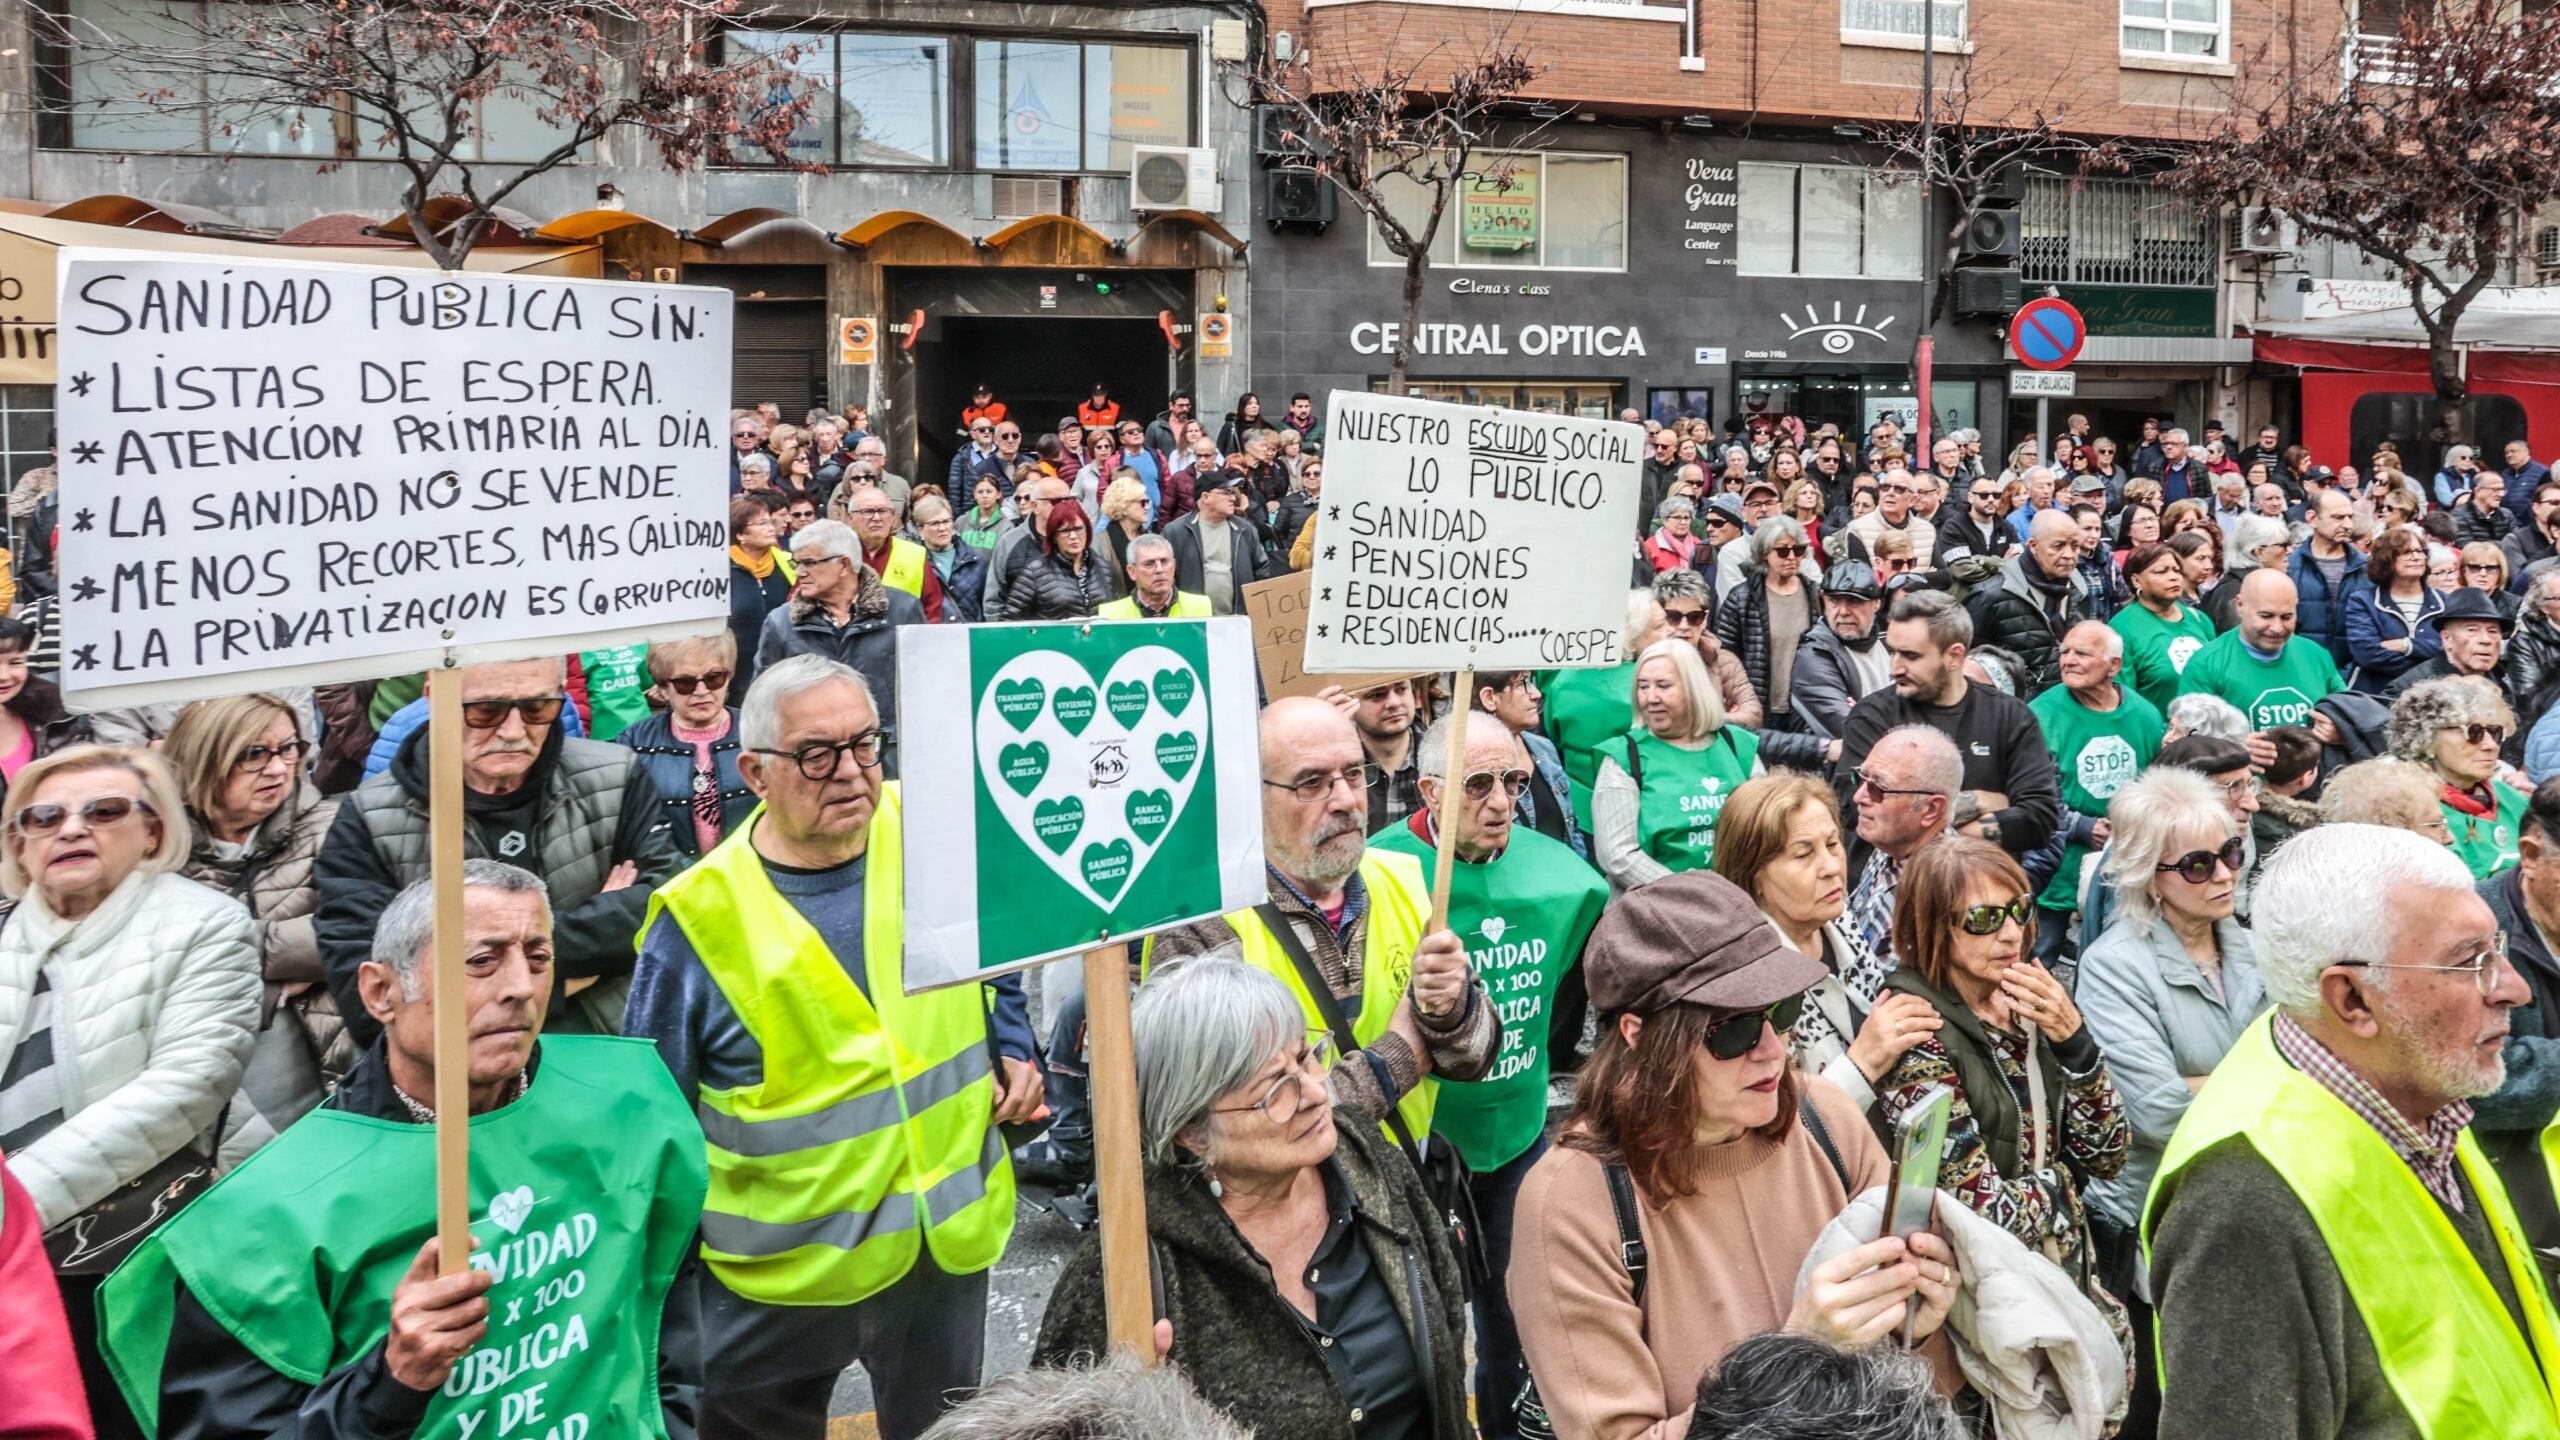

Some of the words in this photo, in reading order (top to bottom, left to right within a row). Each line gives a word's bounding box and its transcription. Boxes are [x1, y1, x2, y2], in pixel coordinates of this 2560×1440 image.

[1685, 158, 1735, 181] Vera
[1685, 183, 1738, 211] Gran
[1471, 205, 1528, 215] HELLO
[1685, 219, 1734, 233] Language
[1684, 238, 1720, 250] Center
[1519, 281, 1550, 295] class
[75, 269, 331, 335] SANIDAD
[371, 275, 582, 331] PUBLICA
[2115, 291, 2176, 323] Gran
[1519, 324, 1646, 357] OPTICA
[1745, 350, 1768, 358] Desde
[112, 353, 325, 412] LISTAS
[361, 361, 430, 403] DE
[463, 360, 662, 406] ESPERA.
[599, 416, 641, 449] AL
[1338, 408, 1450, 446] NUESTRO
[1468, 419, 1547, 456] ESCUDO
[1553, 427, 1635, 465] SOCIAL
[1408, 455, 1440, 493] LO
[109, 495, 166, 538] LA
[192, 474, 378, 531] SANIDAD
[399, 470, 462, 515] NO
[471, 468, 530, 511] SE
[1350, 499, 1487, 543] SANIDAD
[111, 549, 290, 613] MENOS
[318, 526, 526, 592] RECORTES,
[542, 523, 620, 562] MAS
[1351, 540, 1531, 580] PENSIONES
[1346, 581, 1508, 610] EDUCACION
[113, 627, 169, 671] LA
[195, 589, 506, 666] PRIVATIZACION
[528, 585, 567, 616] ES
[1540, 628, 1617, 663] COESPE
[997, 692, 1044, 702] TRANSPORTE
[1003, 701, 1038, 712] PÚBLICO
[1057, 700, 1092, 709] VIVIENDA
[1110, 692, 1145, 702] Pensiones
[1112, 702, 1145, 713] Públicas
[1059, 708, 1091, 719] PÚBLICA
[2258, 702, 2308, 725] STOP
[1157, 744, 1197, 755] RESIDENCIAS
[1160, 753, 1194, 764] PÚBLICAS
[1013, 757, 1036, 767] AGUA
[2085, 751, 2131, 772] STOP
[1006, 766, 1042, 779] PÚBLICA
[1135, 805, 1163, 815] BANCA
[1680, 793, 1728, 812] SANI
[1035, 810, 1083, 826] EDUCACIÓN
[1132, 815, 1166, 826] PÚBLICA
[1689, 814, 1712, 827] 100
[1041, 822, 1078, 837] PÚBLICA
[1087, 855, 1127, 871] SANIDAD
[1089, 867, 1127, 882] PÚBLICA
[1510, 970, 1542, 992] 100
[1503, 1028, 1525, 1054] DE
[1482, 1045, 1537, 1082] LIDAD
[469, 1213, 597, 1285] NIDAD
[533, 1269, 586, 1316] 100
[457, 1409, 487, 1440] Y
[498, 1382, 548, 1438] DE
